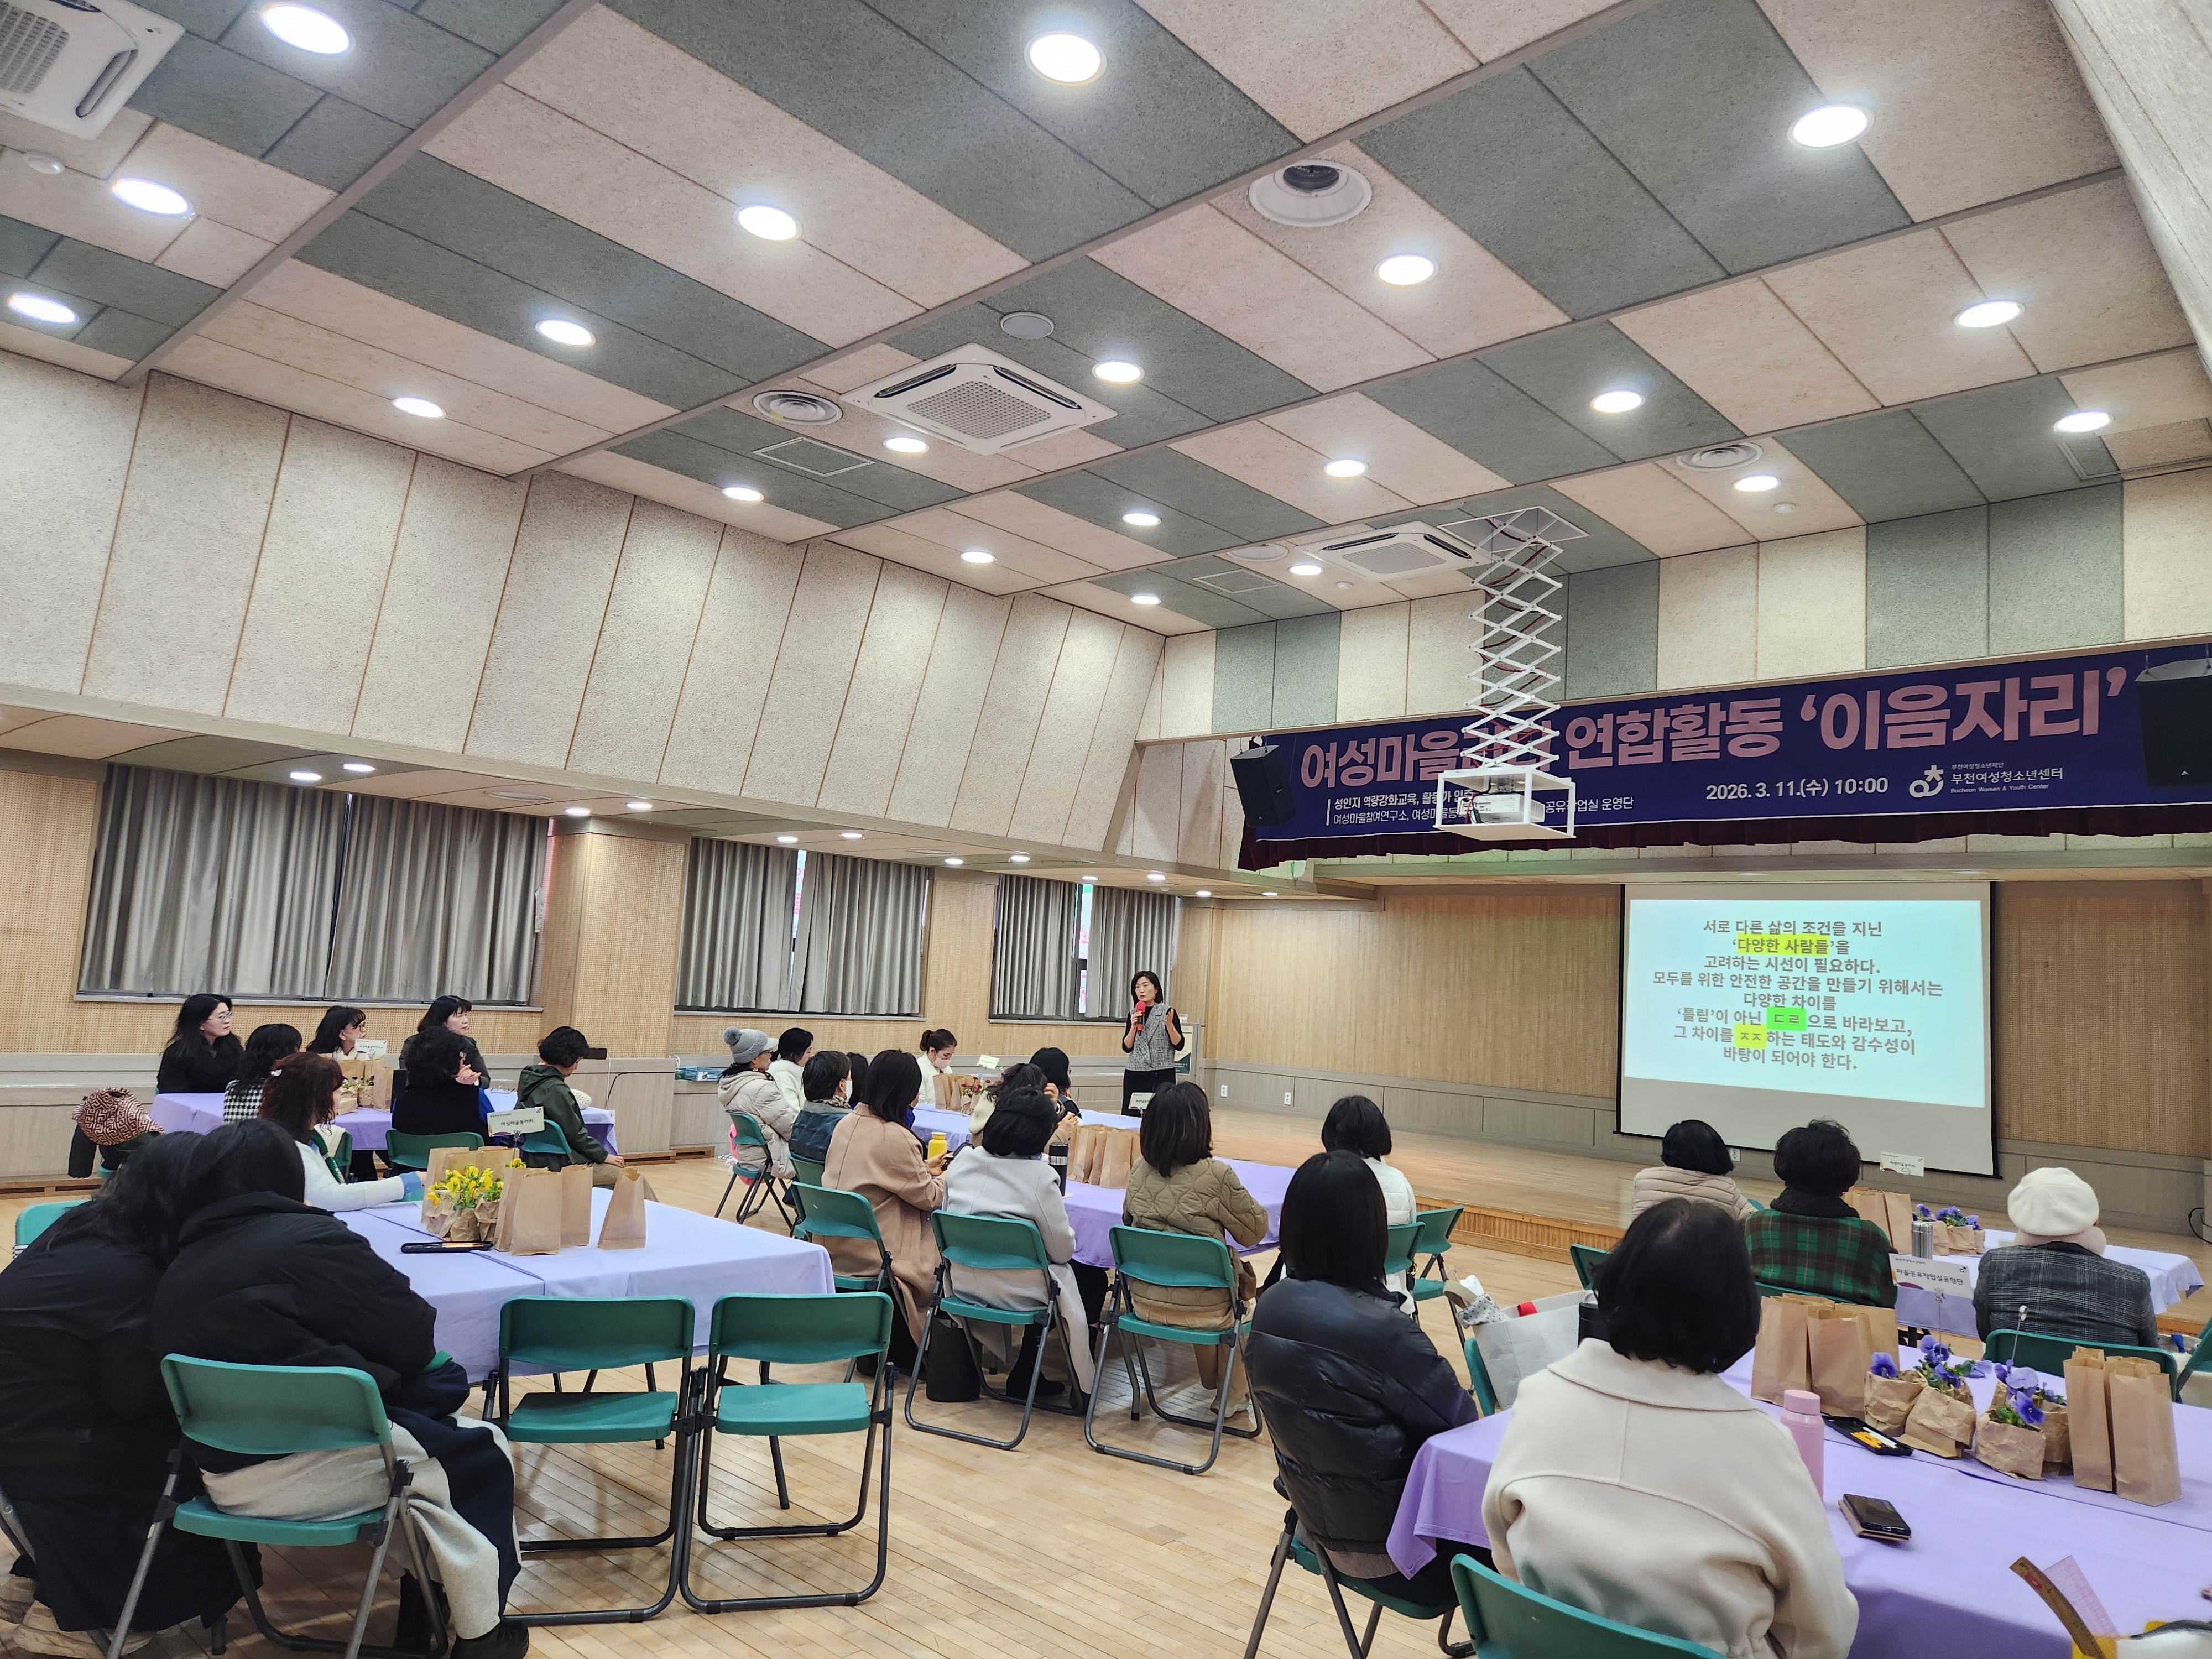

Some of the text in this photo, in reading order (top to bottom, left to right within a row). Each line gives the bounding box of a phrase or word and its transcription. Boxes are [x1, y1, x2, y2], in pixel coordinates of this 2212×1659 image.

[1566, 698, 1783, 770] 연합활동
[1801, 667, 2127, 750] ‘이음자리’
[1951, 767, 2063, 785] 부천여성청소년센터
[1705, 783, 1752, 800] 2026.
[1835, 777, 1888, 794] 10:00
[1333, 810, 1409, 825] 여성마을참여연구소,
[1601, 796, 1634, 811] 운영단
[1334, 797, 1361, 810] 성인지
[1364, 793, 1420, 807] 역량강화교육,
[1704, 920, 1882, 937] 서로 다른 삶의 조건을 지닌
[1732, 938, 1850, 955] ‘다양한 사람들’을
[1704, 956, 1881, 975] 고려하는 시선이 필요하다.
[1653, 972, 1944, 997] 모두를 위한 안전한 공간을 만들기 위해서는
[1744, 992, 1837, 1011] 다양한 차이를
[1677, 1007, 1729, 1024] ‘틀림’이
[1734, 1010, 1761, 1026] 아닌
[1807, 1014, 1838, 1030] 으로
[1843, 1016, 1912, 1037] 바라보고,
[1674, 1025, 1687, 1038] 그
[1692, 1026, 1734, 1043] 차이를
[1767, 1030, 1796, 1047] 하는
[1801, 1032, 1846, 1050] 태도와
[1852, 1036, 1915, 1056] 감수성이
[1724, 1046, 1858, 1071] 바탕이 되어야 한다.
